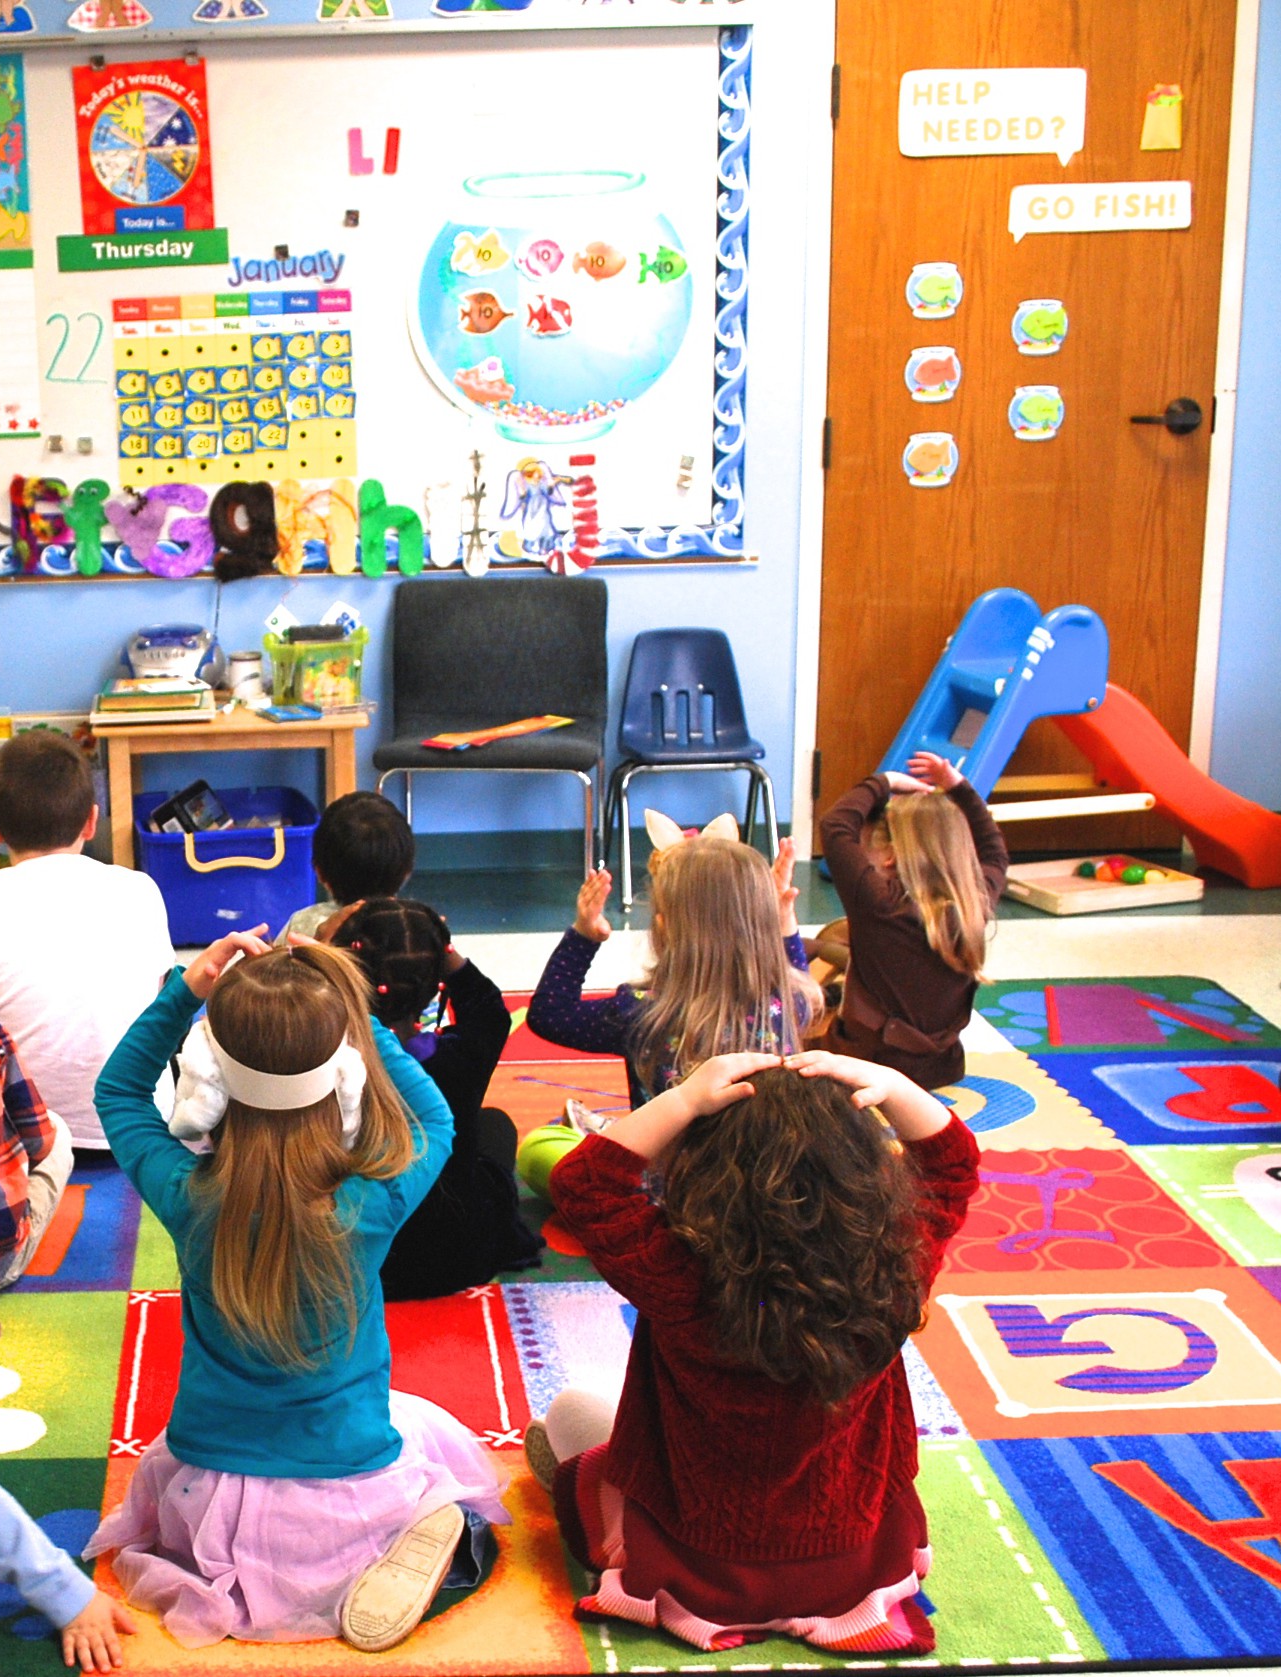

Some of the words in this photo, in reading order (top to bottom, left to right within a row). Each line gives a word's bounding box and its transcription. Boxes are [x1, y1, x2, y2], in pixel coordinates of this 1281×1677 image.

[78, 75, 125, 118] Today's
[127, 74, 186, 96] weather
[913, 80, 991, 106] HELP
[922, 115, 1067, 143] NEEDED?
[1028, 196, 1075, 220] GO
[1094, 192, 1177, 218] FISH!
[123, 217, 154, 229] Today
[92, 240, 194, 260] Thursday
[227, 249, 346, 287] January
[45, 312, 108, 384] 22
[983, 1303, 1218, 1395] G
